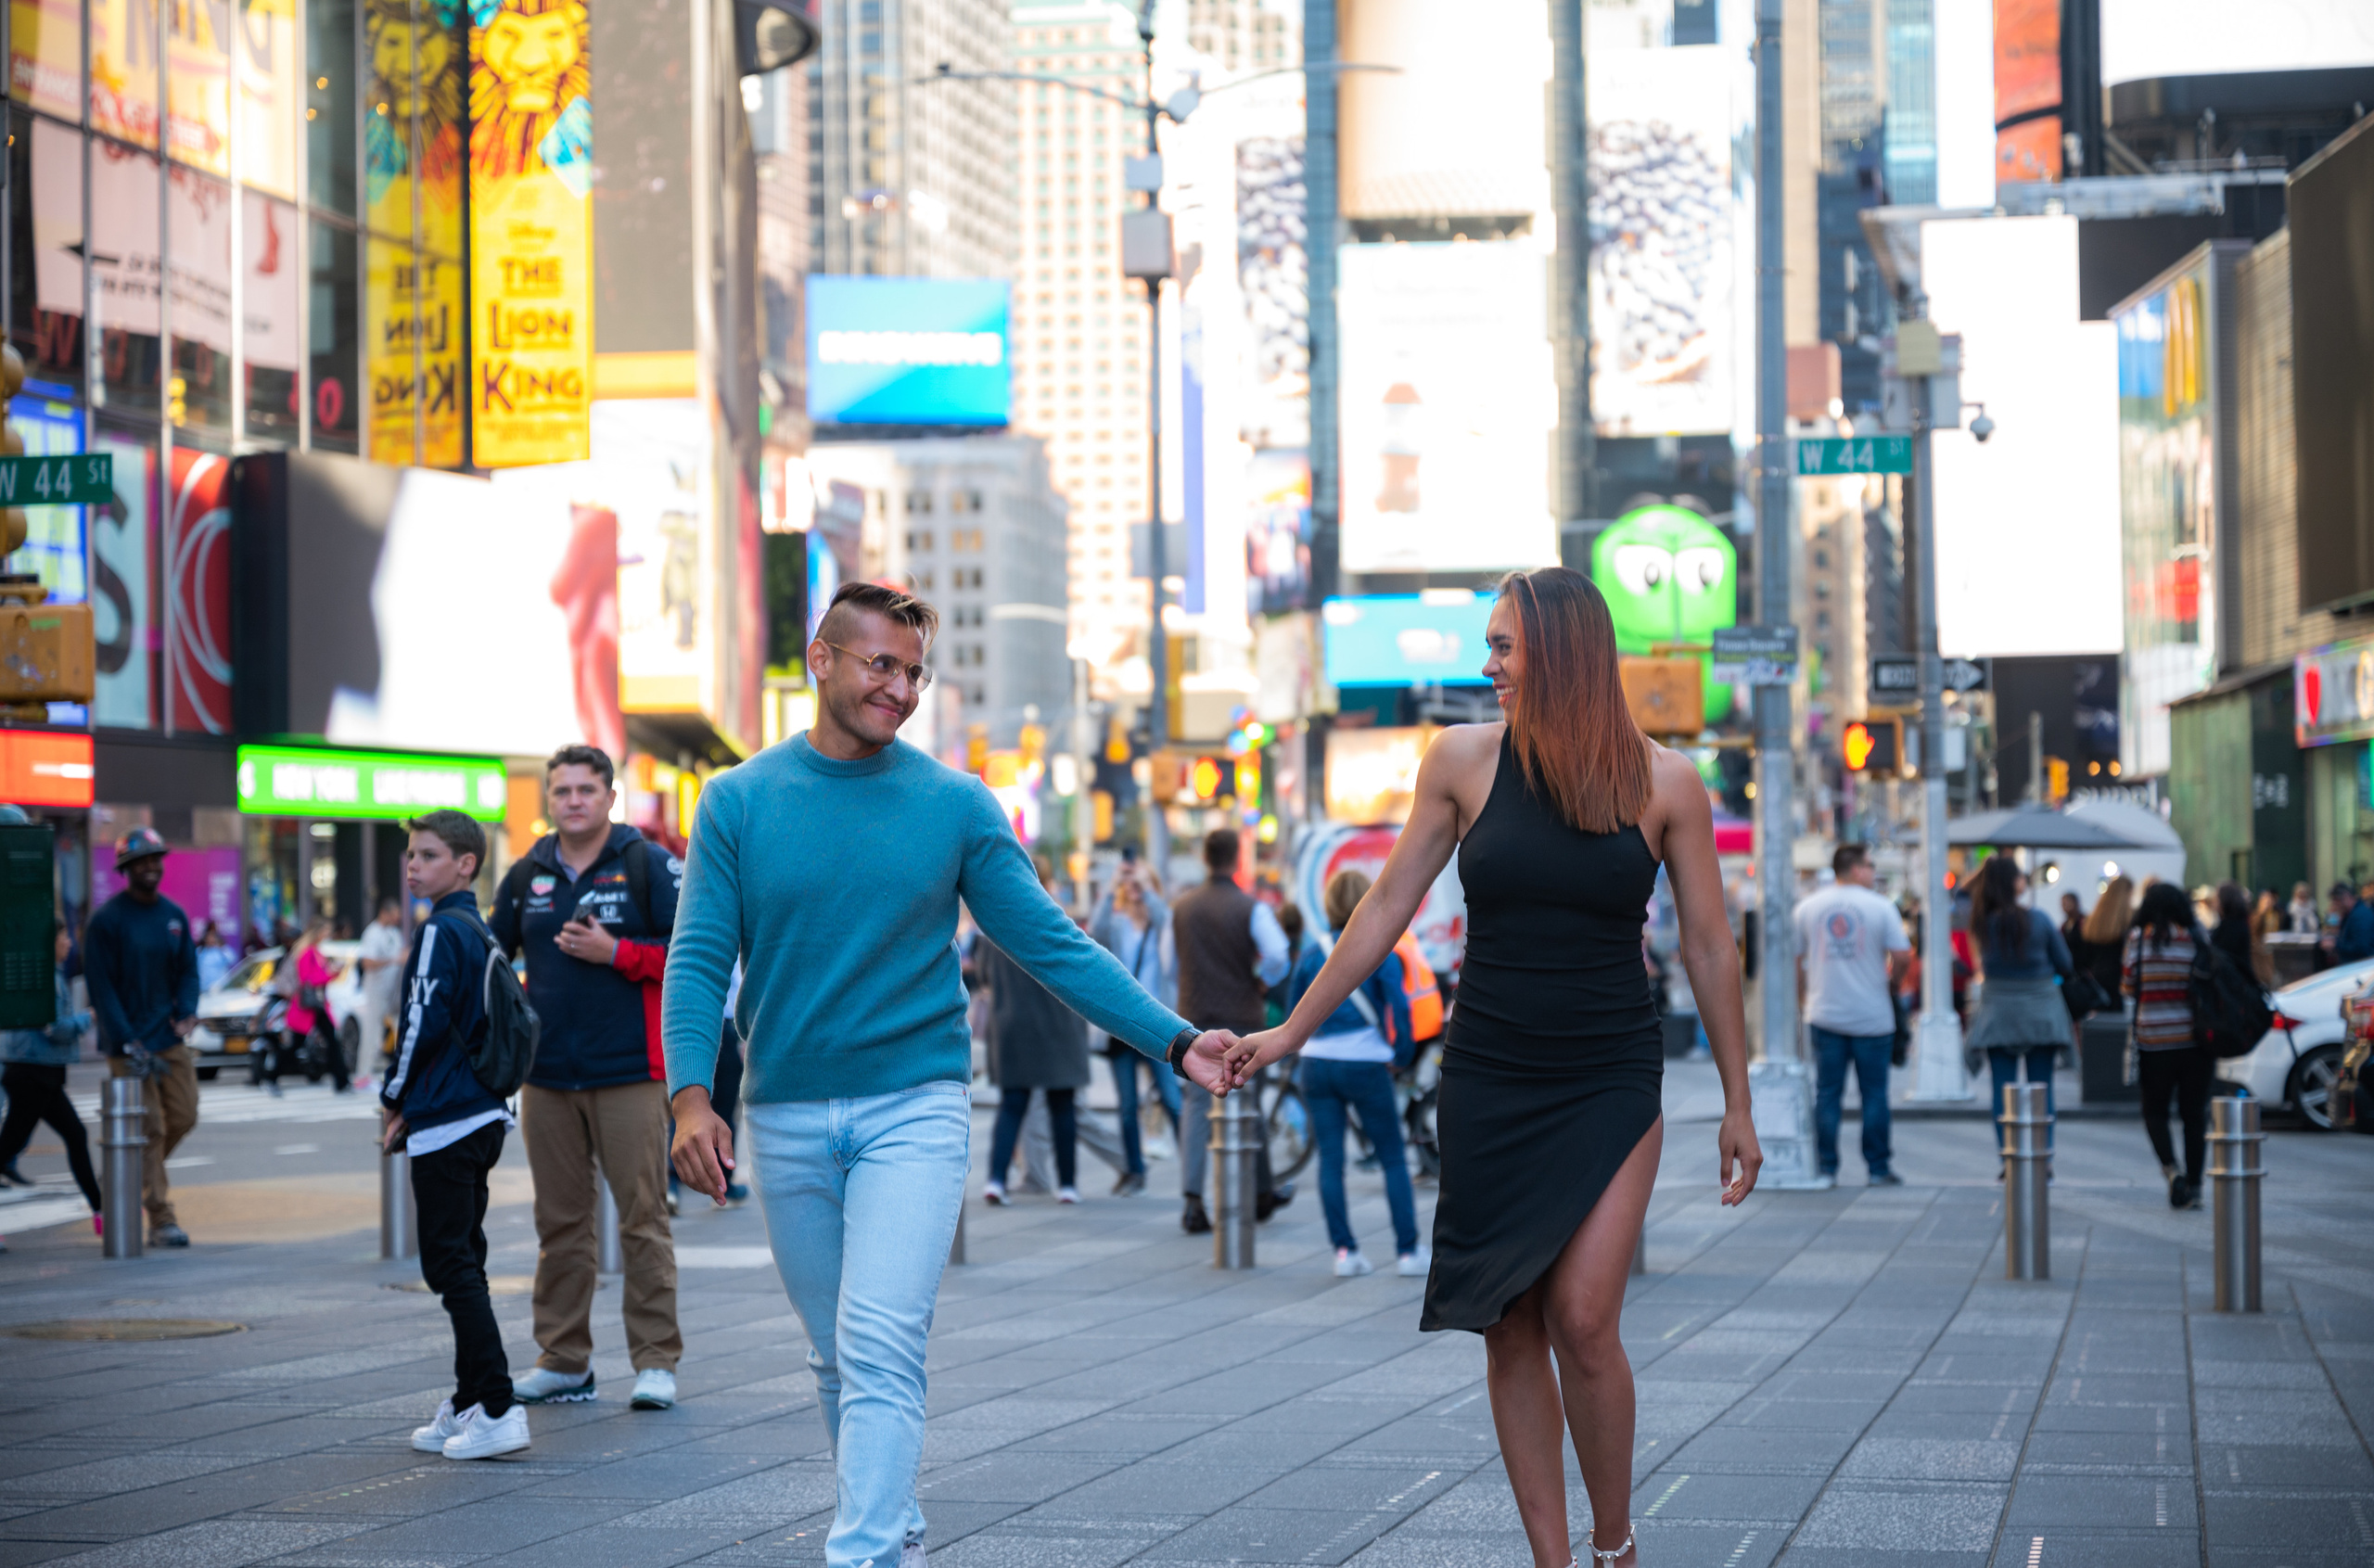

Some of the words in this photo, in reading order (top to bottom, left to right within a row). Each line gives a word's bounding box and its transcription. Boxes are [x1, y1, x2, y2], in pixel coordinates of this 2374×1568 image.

[501, 259, 560, 283] THE
[482, 361, 581, 411] KING
[1801, 440, 1824, 474] W
[1837, 439, 1874, 472] 44
[33, 460, 71, 500] 44
